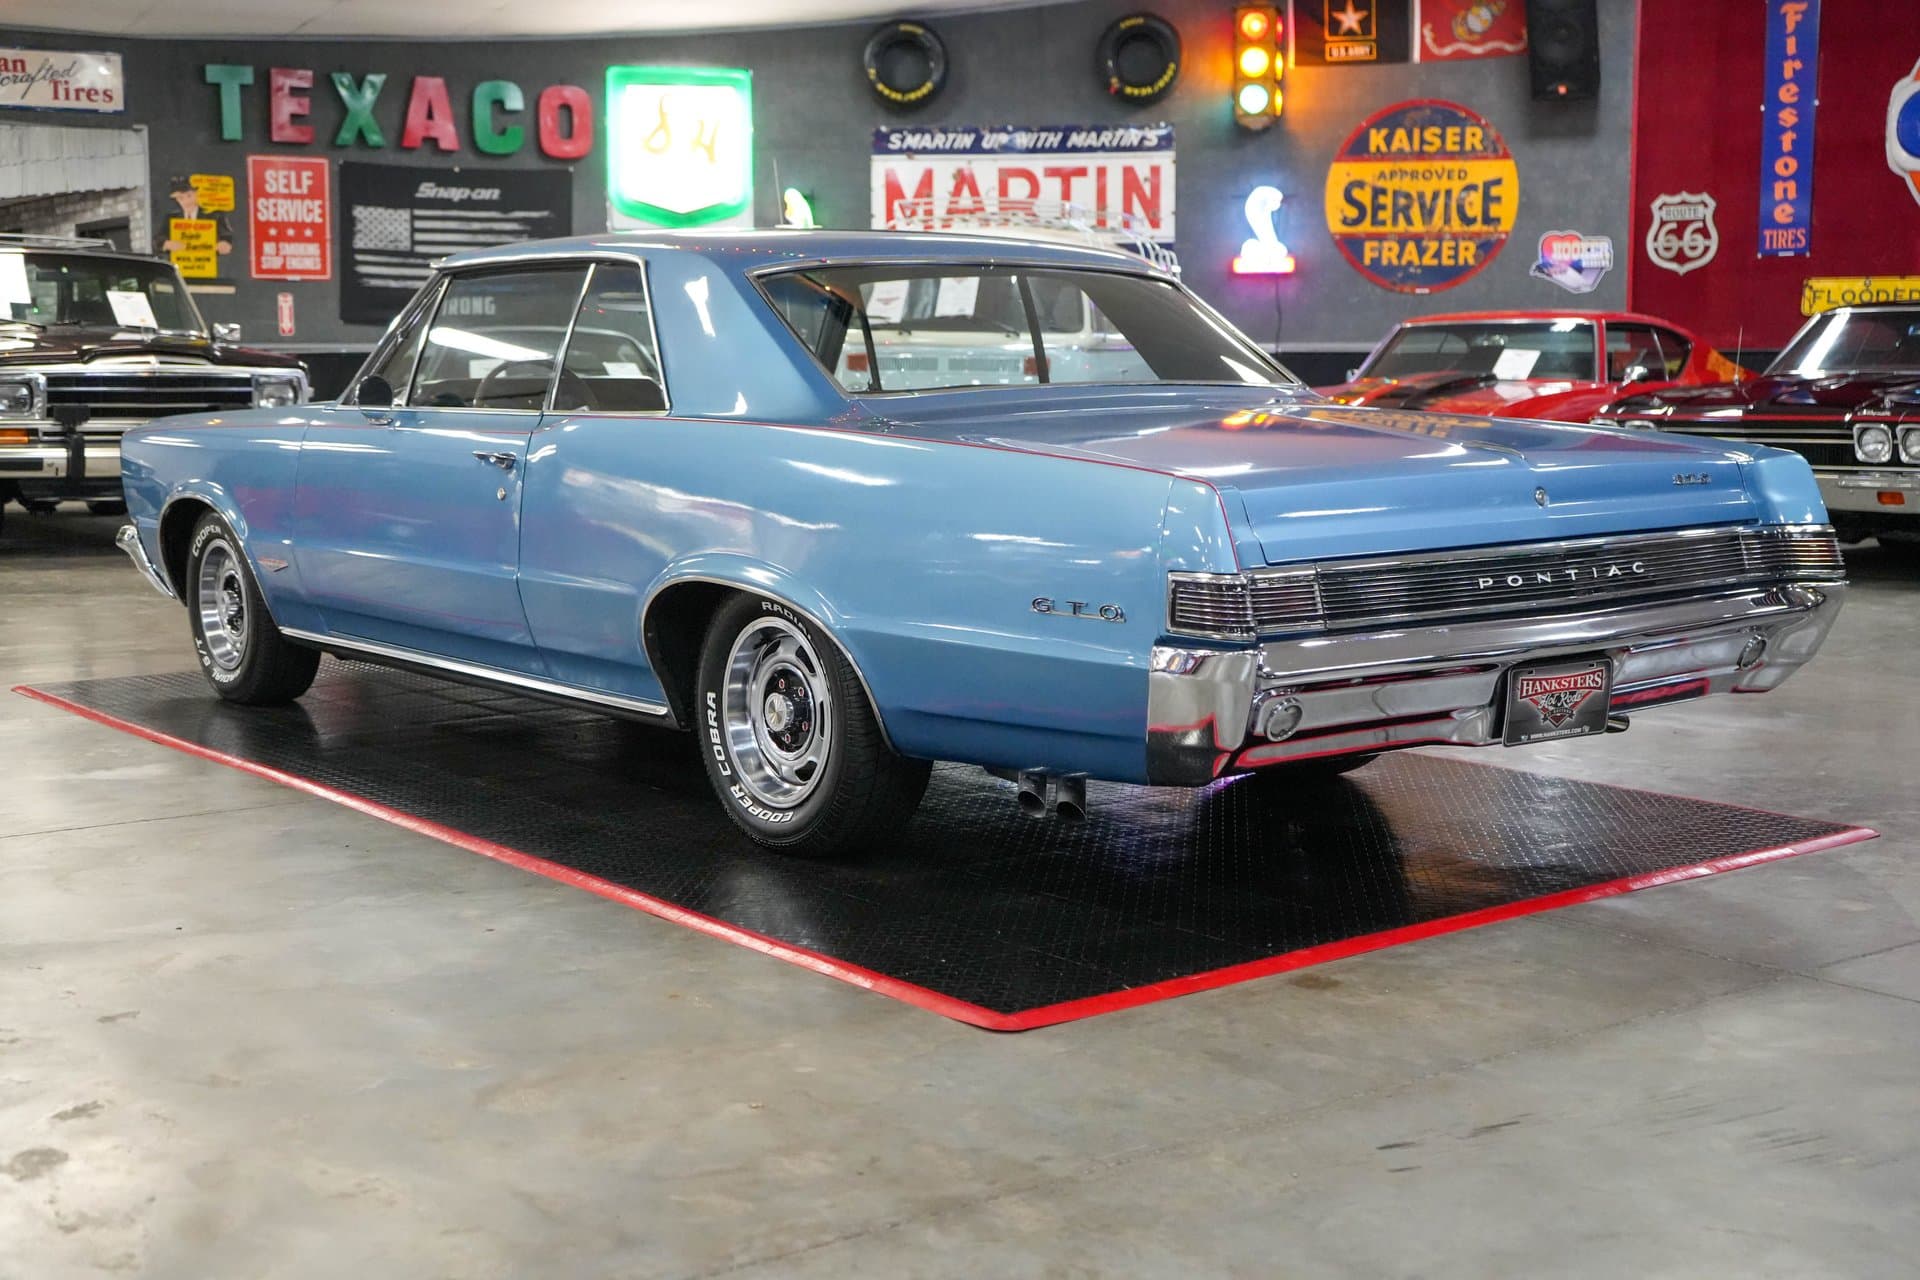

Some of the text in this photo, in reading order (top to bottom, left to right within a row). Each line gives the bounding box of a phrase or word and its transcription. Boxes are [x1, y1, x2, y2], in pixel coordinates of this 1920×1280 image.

[49, 79, 113, 103] Tires
[206, 64, 593, 159] TEXACO
[1773, 2, 1808, 225] Firestone
[1014, 131, 1061, 149] WITH
[1369, 126, 1484, 153] KAISER
[265, 169, 313, 195] SELF
[1377, 168, 1468, 181] APPROVED
[415, 182, 501, 202] Snap-on
[885, 165, 1161, 231] MARTIN
[1341, 178, 1503, 227] SERVICE
[257, 198, 323, 223] SERVICE
[1657, 221, 1706, 260] 66
[1764, 228, 1806, 250] TIRES
[1363, 240, 1477, 267] FRAZER
[192, 524, 222, 558] COOPER
[1478, 562, 1645, 590] PONTIAC
[1031, 597, 1124, 622] GTO
[1522, 671, 1603, 697] HANKSTERS
[1539, 692, 1559, 709] Hot
[707, 691, 732, 777] COBRA
[729, 783, 794, 823] COOPER
